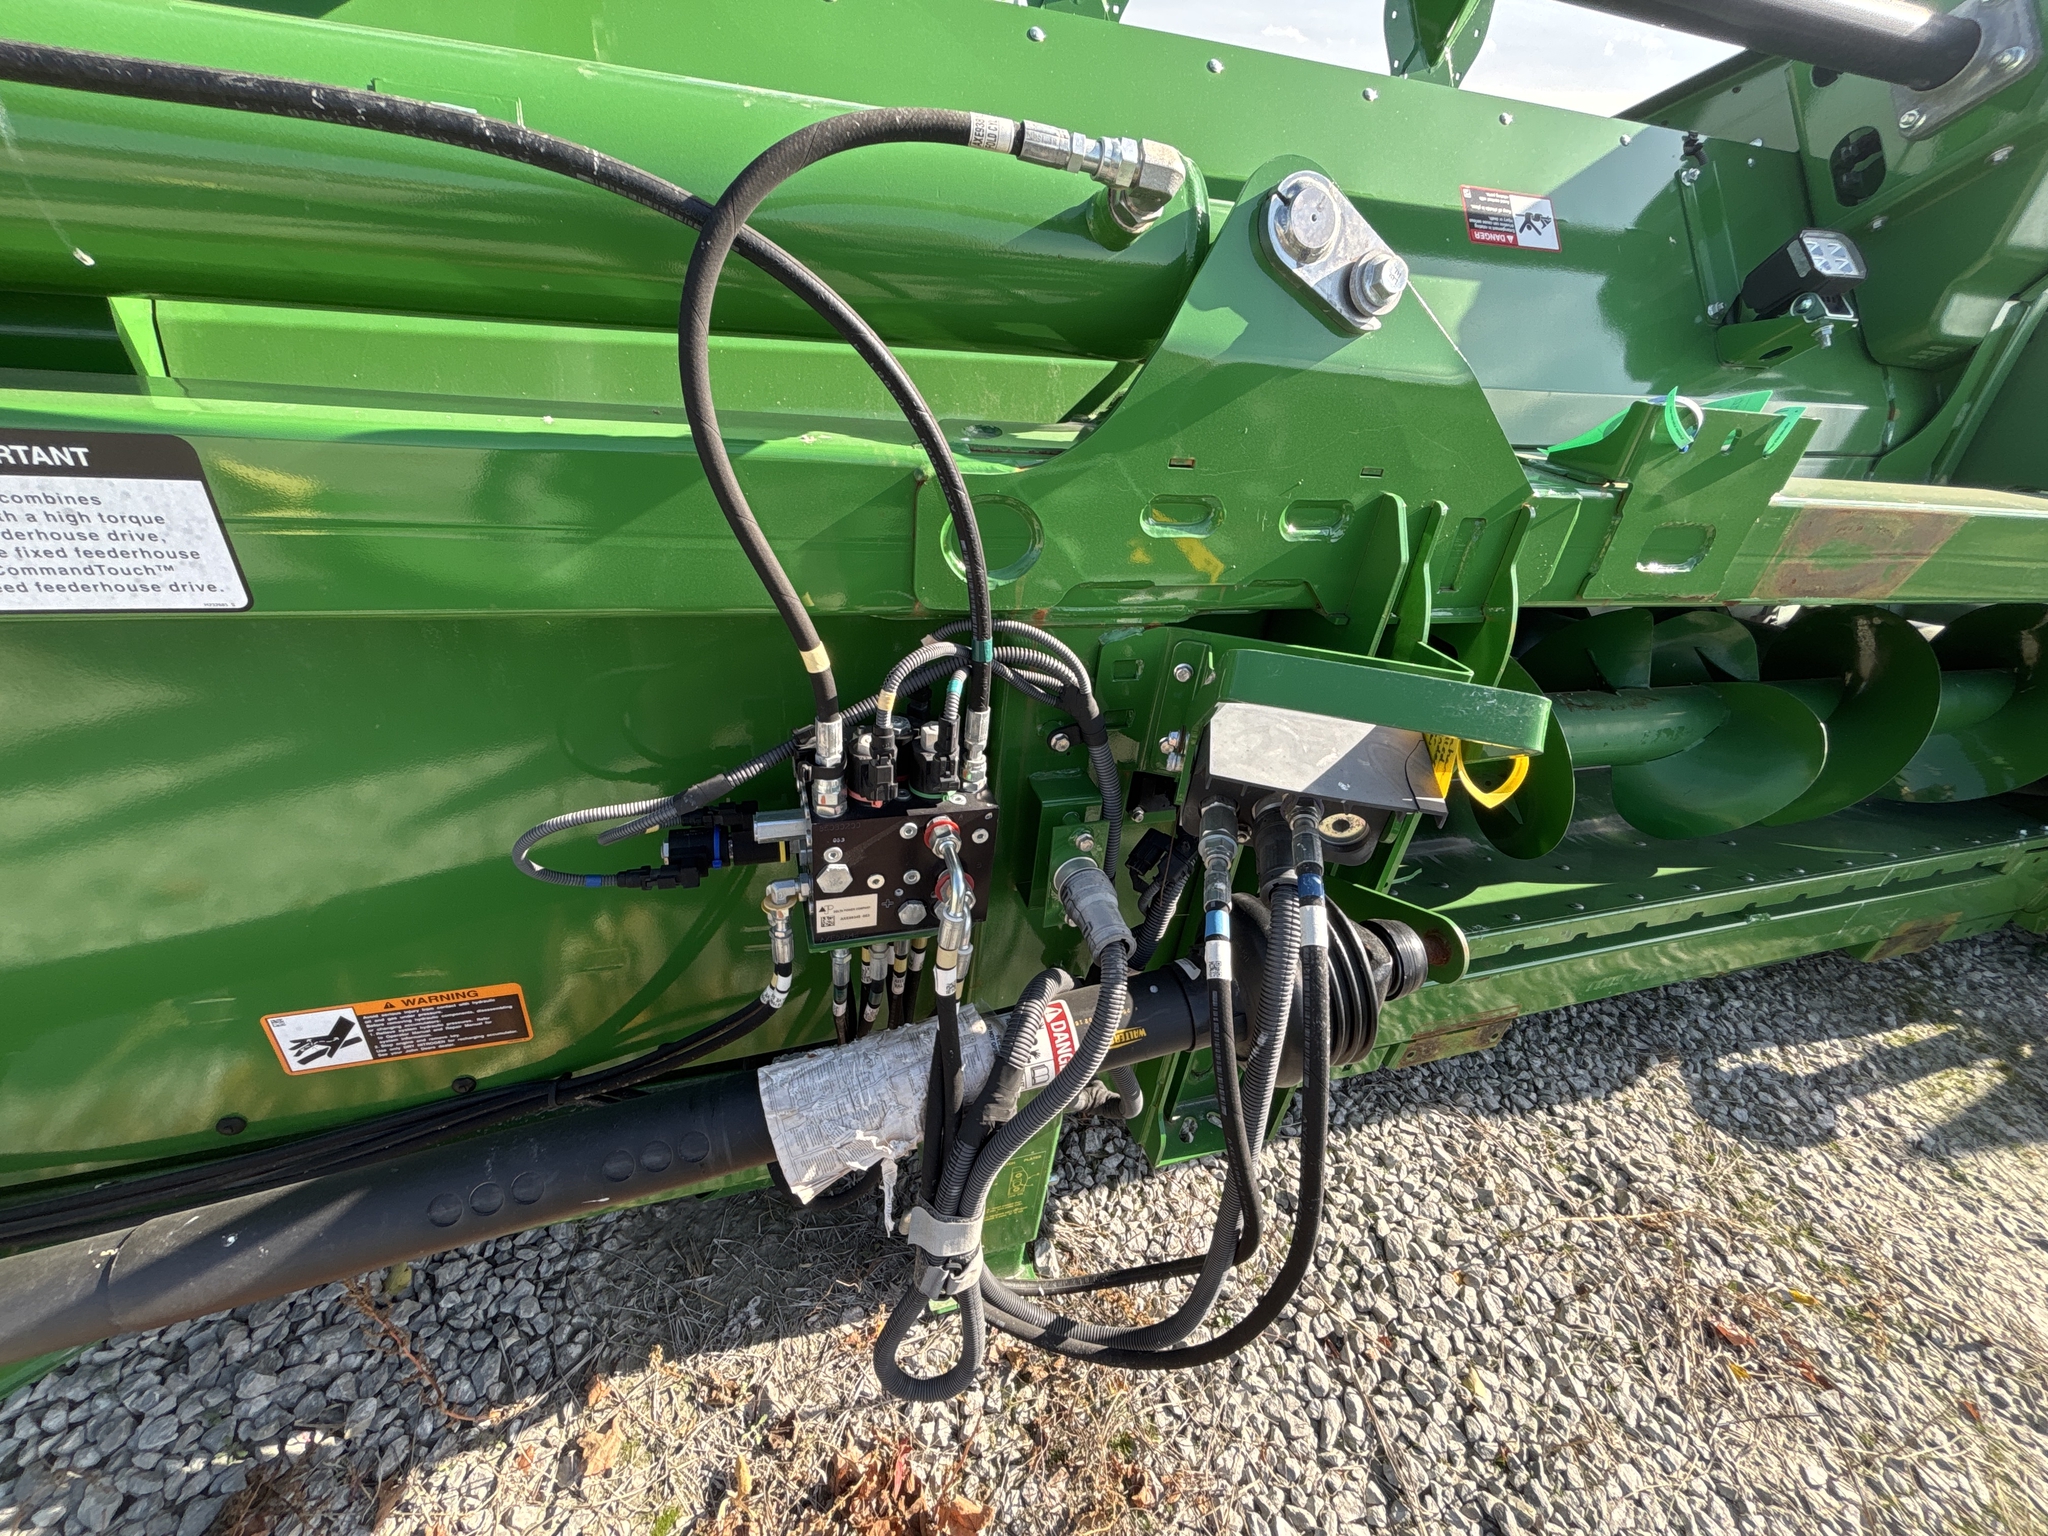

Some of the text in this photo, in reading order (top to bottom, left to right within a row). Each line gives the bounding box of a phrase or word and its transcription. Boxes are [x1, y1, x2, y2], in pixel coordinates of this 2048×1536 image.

[1474, 230, 1506, 242] DANGER
[0, 492, 102, 506] combines
[25, 513, 38, 522] a
[44, 512, 91, 526] high
[100, 512, 165, 527] torque
[1, 529, 166, 544] derhouse drive,
[15, 546, 67, 559] fixed
[74, 547, 200, 560] feederhouse
[36, 582, 161, 593] feederhouse
[169, 582, 224, 593] drive.
[401, 990, 478, 1006] WARNING
